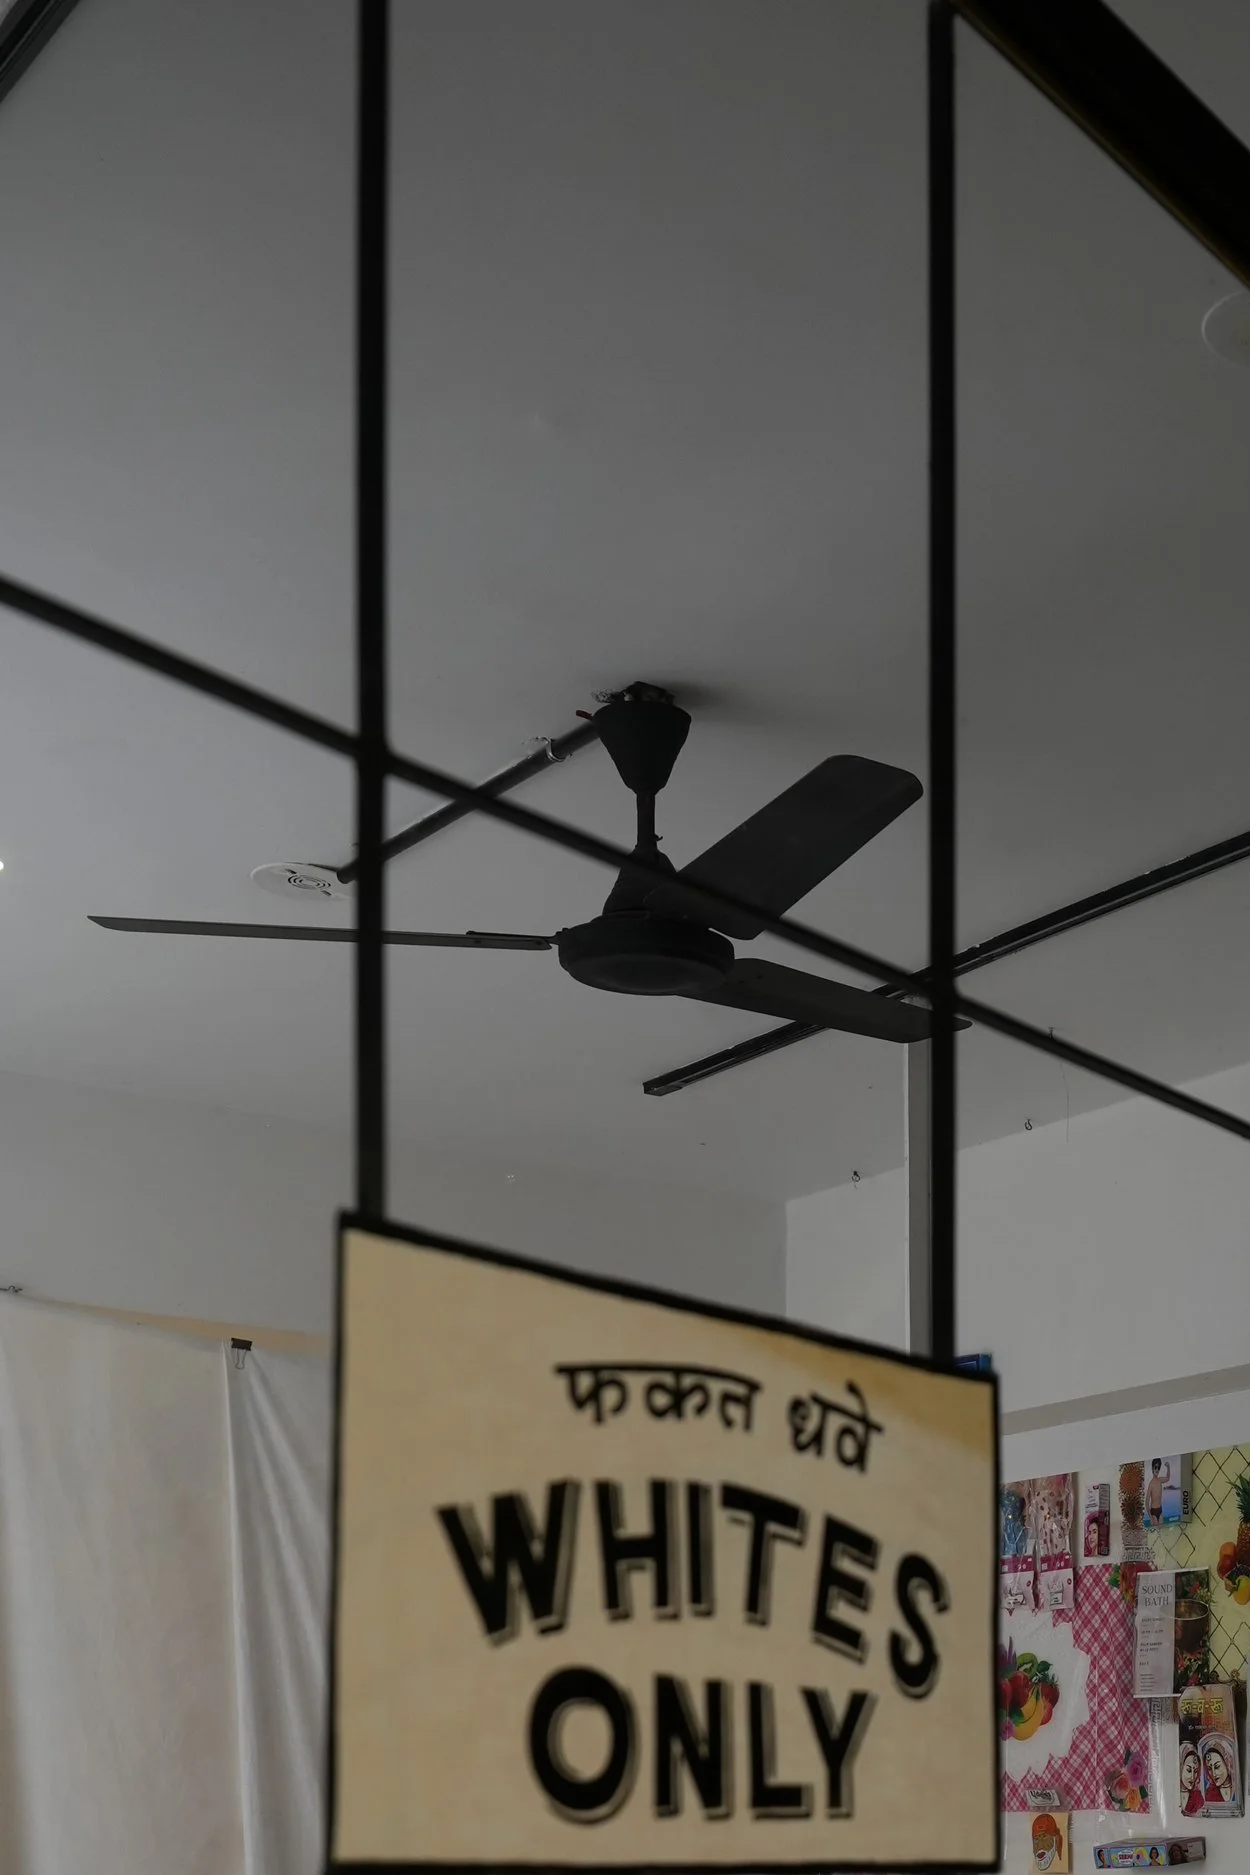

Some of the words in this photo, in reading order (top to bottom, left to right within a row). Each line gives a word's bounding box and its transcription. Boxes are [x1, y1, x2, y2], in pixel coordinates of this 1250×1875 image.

[555, 1363, 764, 1434] फकत
[437, 1477, 952, 1702] WHITES
[1142, 1583, 1173, 1595] SOUND
[1144, 1596, 1169, 1607] BATH
[526, 1665, 878, 1825] ONLY
